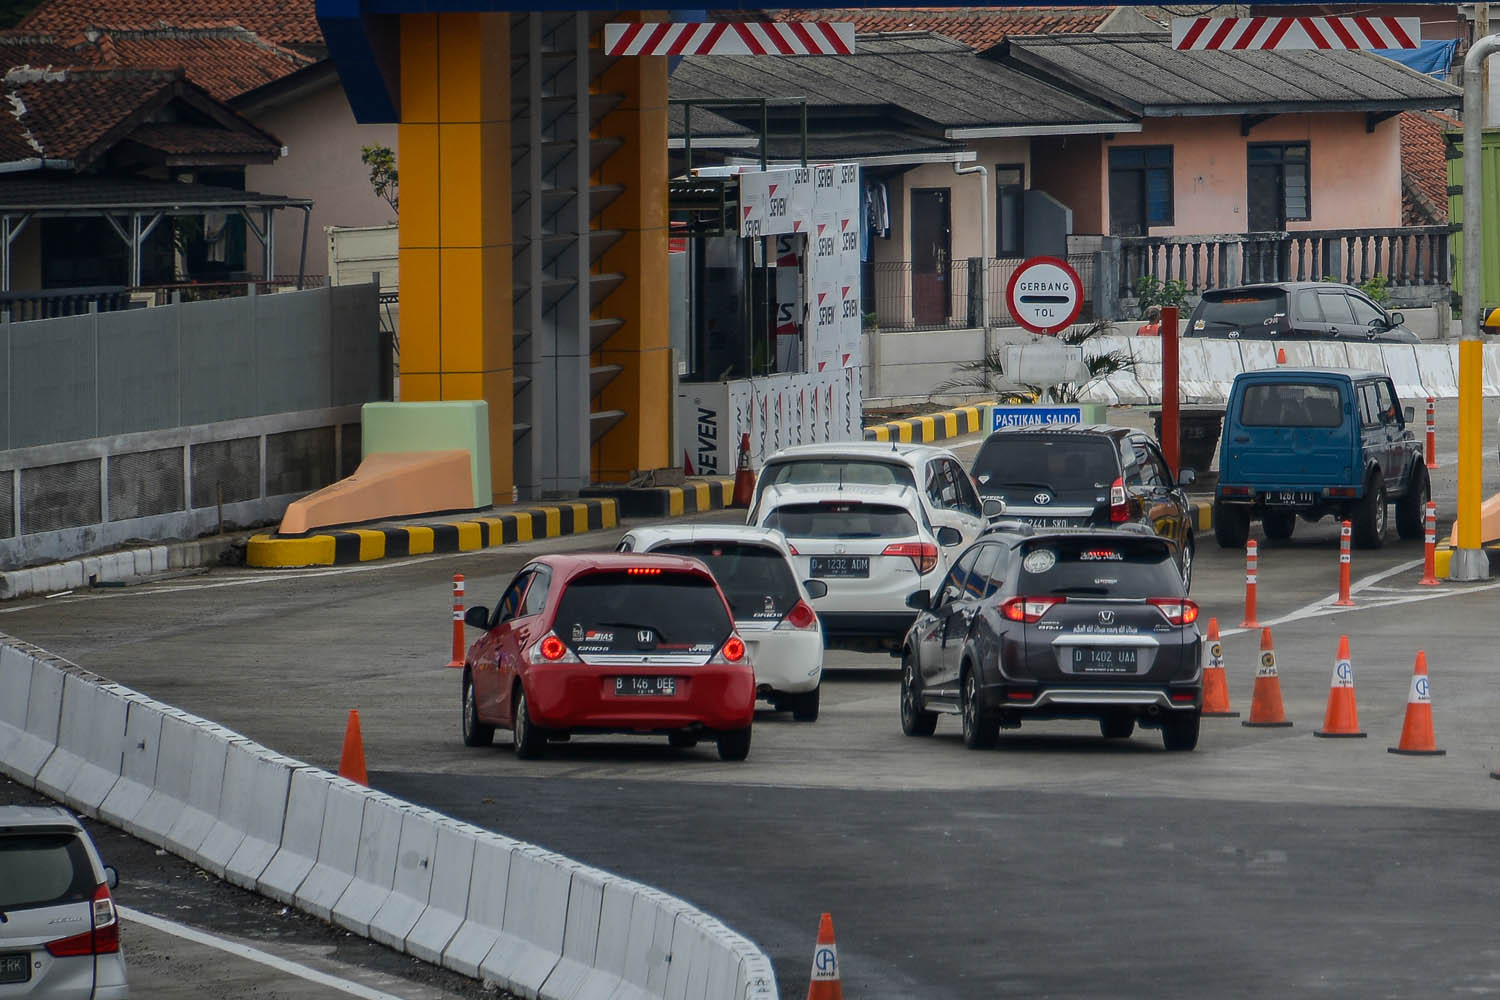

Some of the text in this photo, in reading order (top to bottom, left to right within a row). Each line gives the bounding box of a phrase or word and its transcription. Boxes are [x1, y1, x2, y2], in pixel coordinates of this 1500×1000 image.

[1020, 282, 1070, 292] GERBANG
[1034, 308, 1055, 318] TOL
[995, 414, 1077, 426] PASTIKAN SALDO
[826, 559, 848, 570] 1232
[1091, 651, 1112, 662] 1402
[1118, 651, 1136, 663] UAA
[616, 679, 623, 689] B
